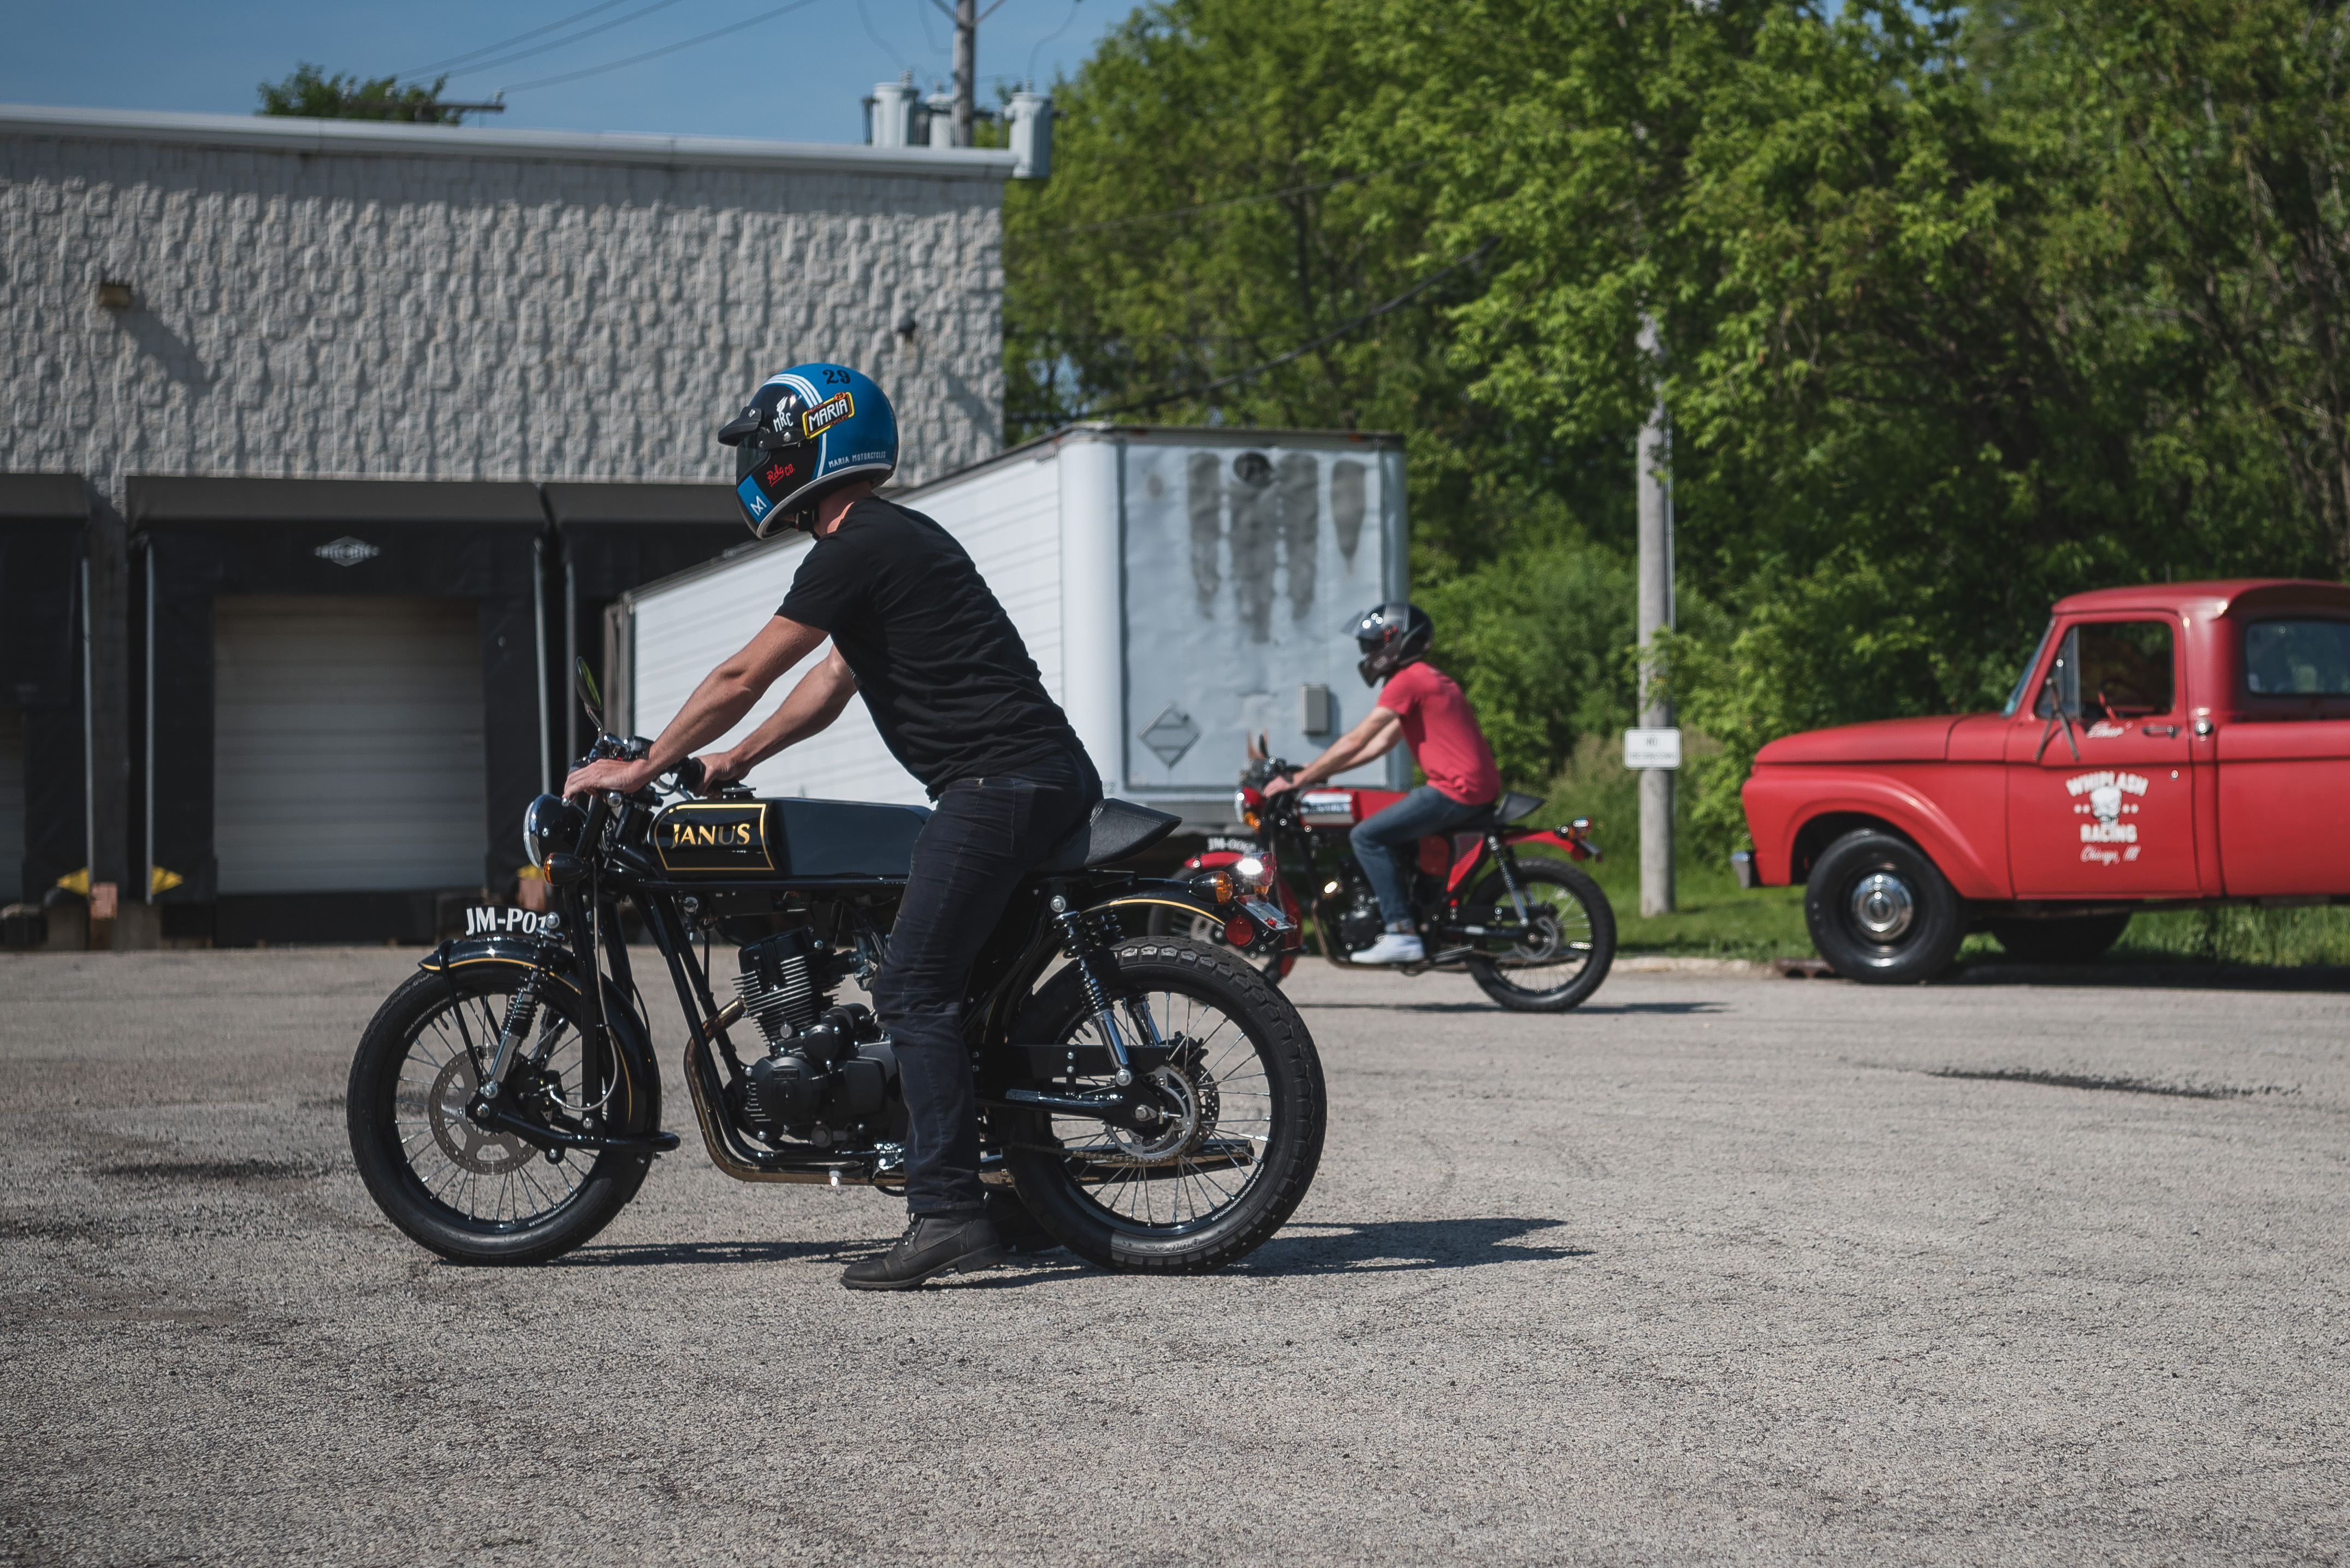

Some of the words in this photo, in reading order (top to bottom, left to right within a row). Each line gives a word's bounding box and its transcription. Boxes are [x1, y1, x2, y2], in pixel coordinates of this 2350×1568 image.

[822, 369, 851, 384] 29
[773, 412, 794, 432] MRC
[808, 399, 848, 431] MARIA
[828, 456, 849, 468] MARIA
[852, 451, 886, 462] MOTORCYCLES
[1646, 737, 1658, 746] NO
[2065, 770, 2149, 797] WHIPLASH
[670, 823, 750, 850] JANUS
[2079, 823, 2138, 843] RACING
[1255, 1162, 1264, 1179] JANUS
[1240, 1178, 1256, 1199] AMERICAN
[559, 1192, 578, 1211] AMERICAN
[1211, 1198, 1241, 1221] MOTORCYCLES
[528, 1209, 560, 1227] MOTORCYCLES
